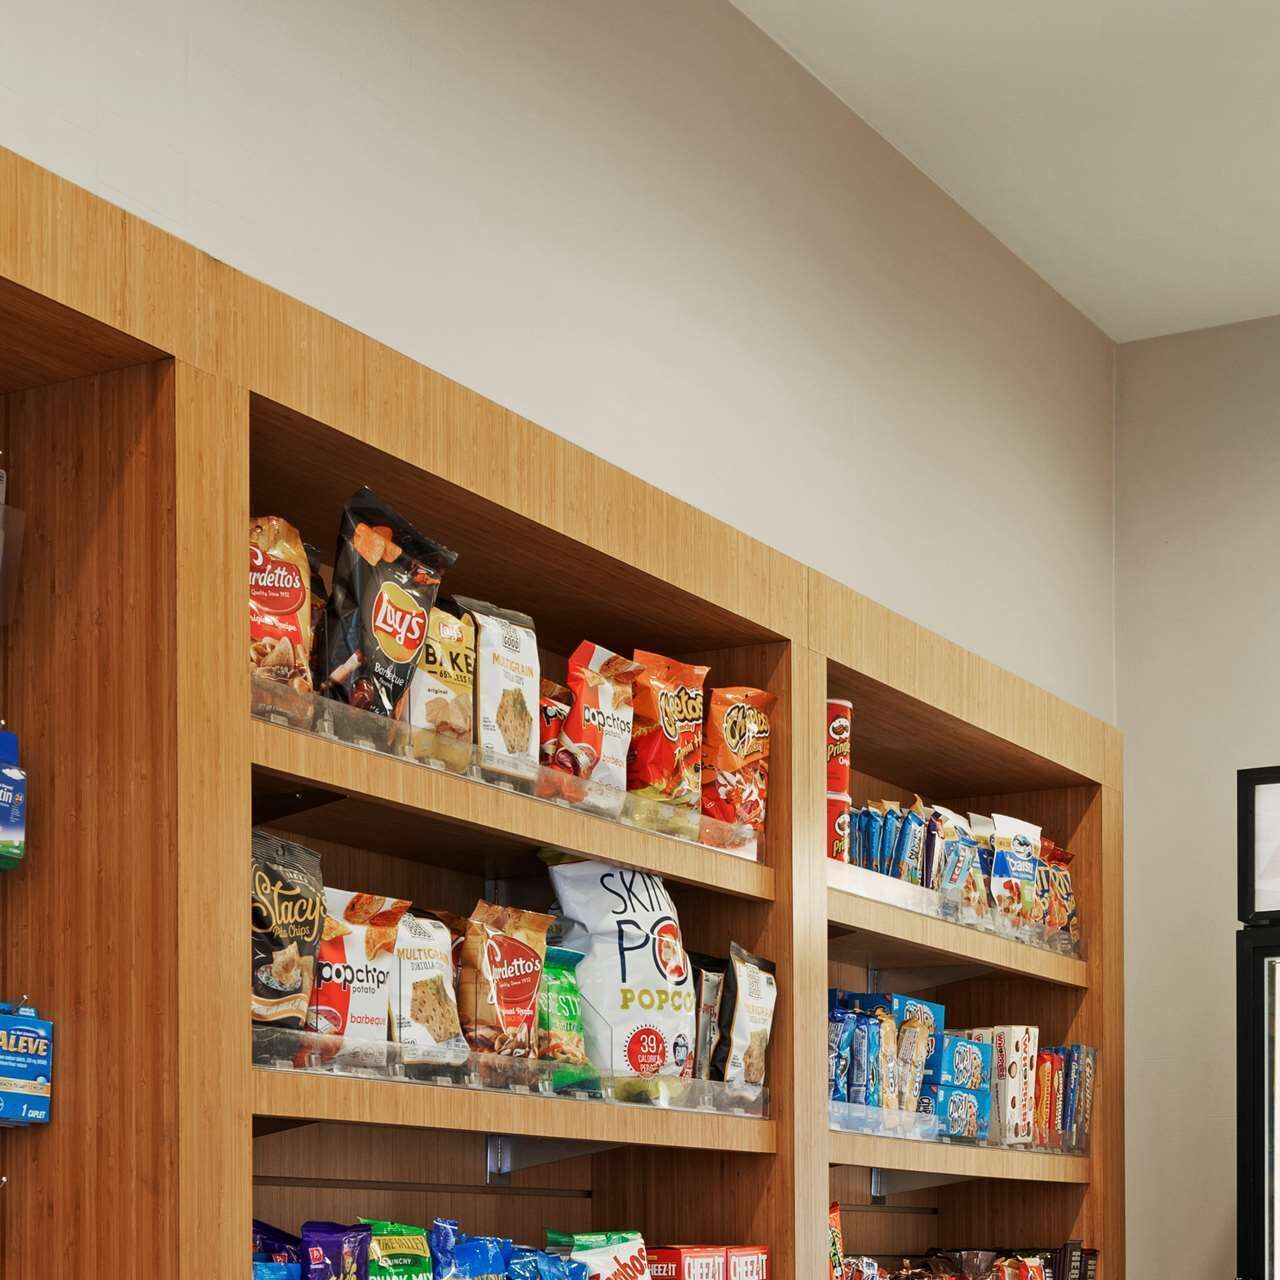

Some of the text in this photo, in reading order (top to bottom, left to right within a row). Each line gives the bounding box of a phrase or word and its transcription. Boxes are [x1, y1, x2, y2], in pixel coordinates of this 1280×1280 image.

[376, 594, 425, 645] Lay's
[583, 704, 631, 734] popchips
[288, 925, 311, 938] Chips
[352, 984, 376, 995] potato
[639, 1034, 656, 1053] 39
[996, 1032, 1006, 1080] WHOPPERS
